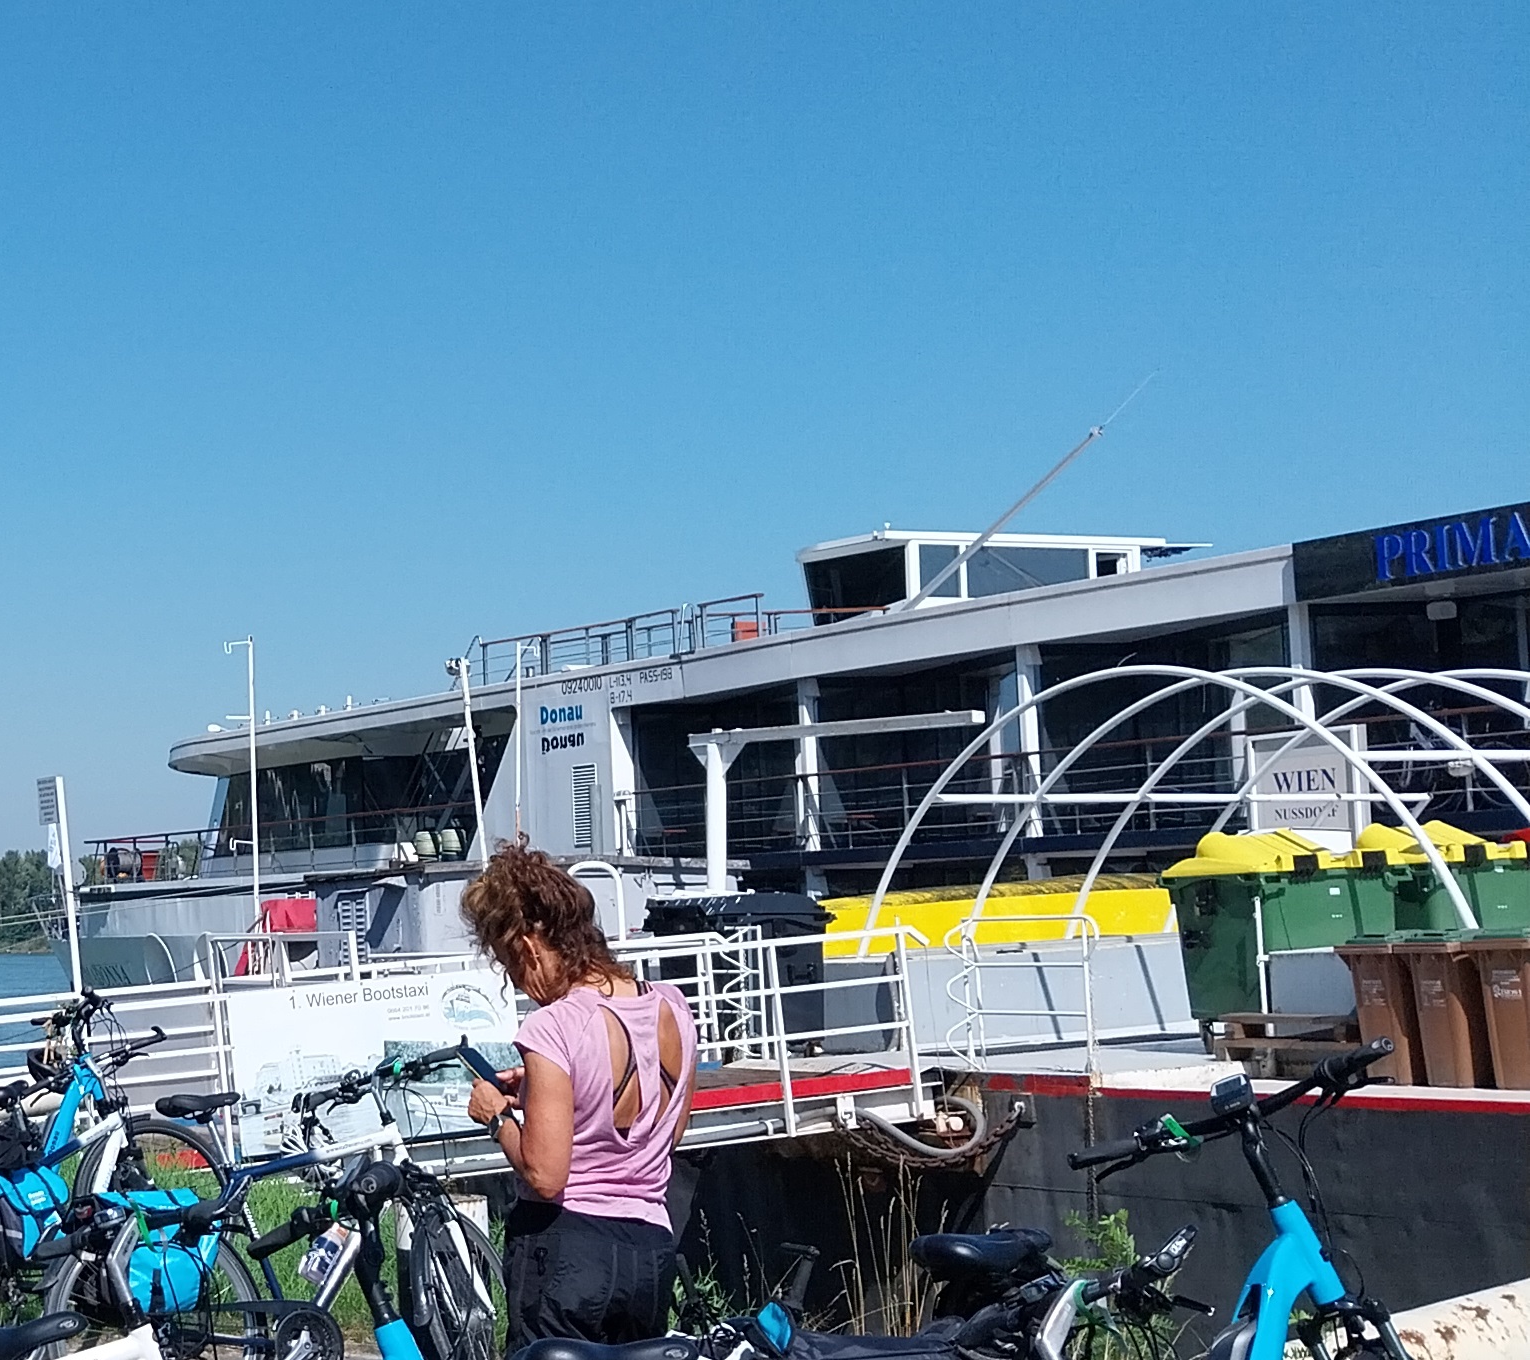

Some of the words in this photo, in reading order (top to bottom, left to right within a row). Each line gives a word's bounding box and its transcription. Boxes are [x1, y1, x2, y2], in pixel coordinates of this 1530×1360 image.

[561, 676, 602, 695] 09240010
[540, 704, 583, 725] Donau
[1273, 767, 1337, 793] WIEN
[1274, 803, 1339, 821] NUSSDOF
[306, 990, 358, 1008] Wiener
[363, 982, 429, 1002] Bootstaxi
